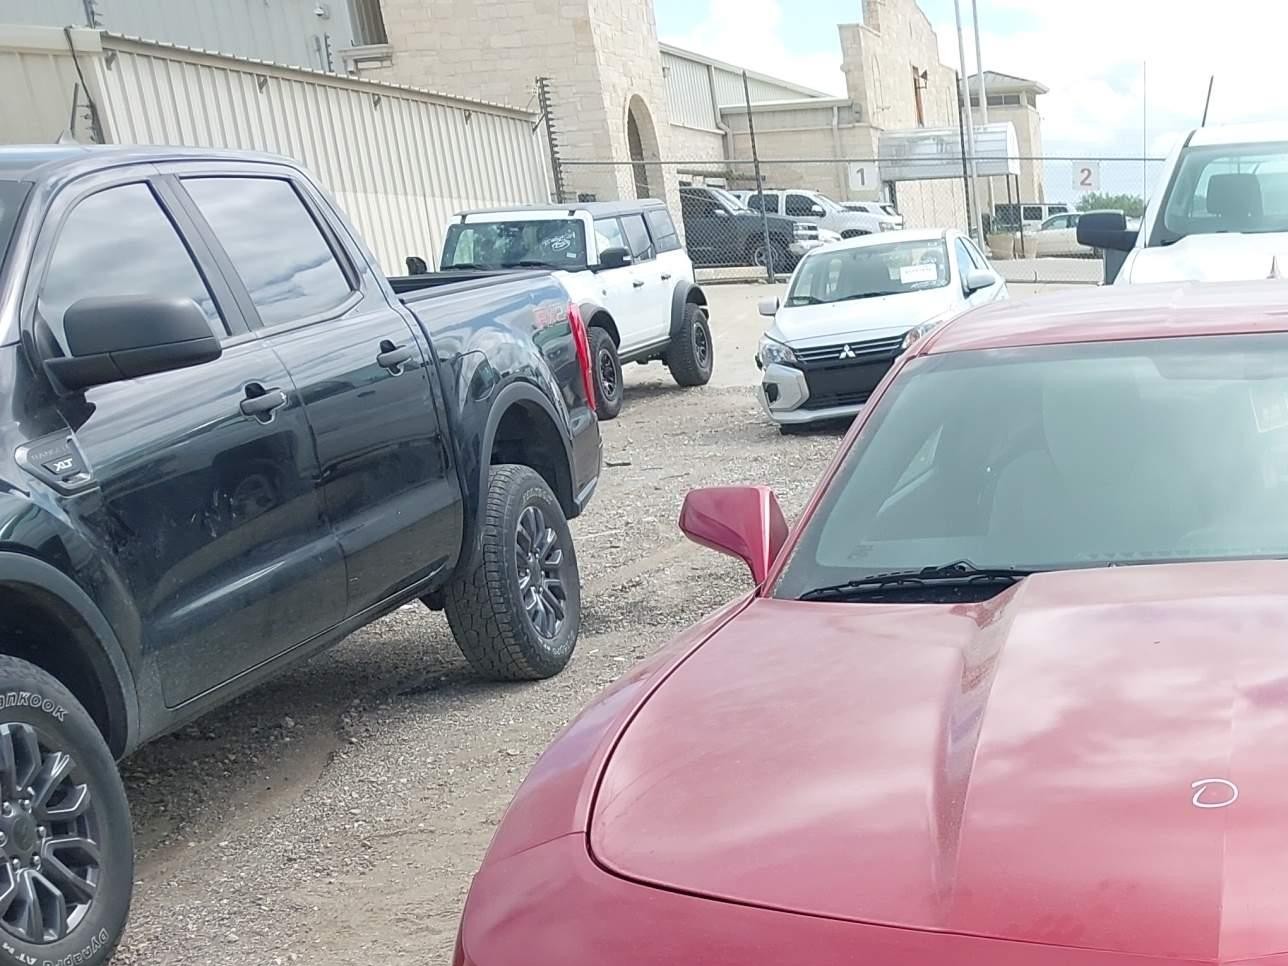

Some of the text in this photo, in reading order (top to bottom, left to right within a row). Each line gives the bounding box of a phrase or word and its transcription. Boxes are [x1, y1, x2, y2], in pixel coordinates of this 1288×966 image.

[856, 167, 865, 186] 1
[1080, 167, 1093, 186] 2
[53, 457, 73, 472] XLT
